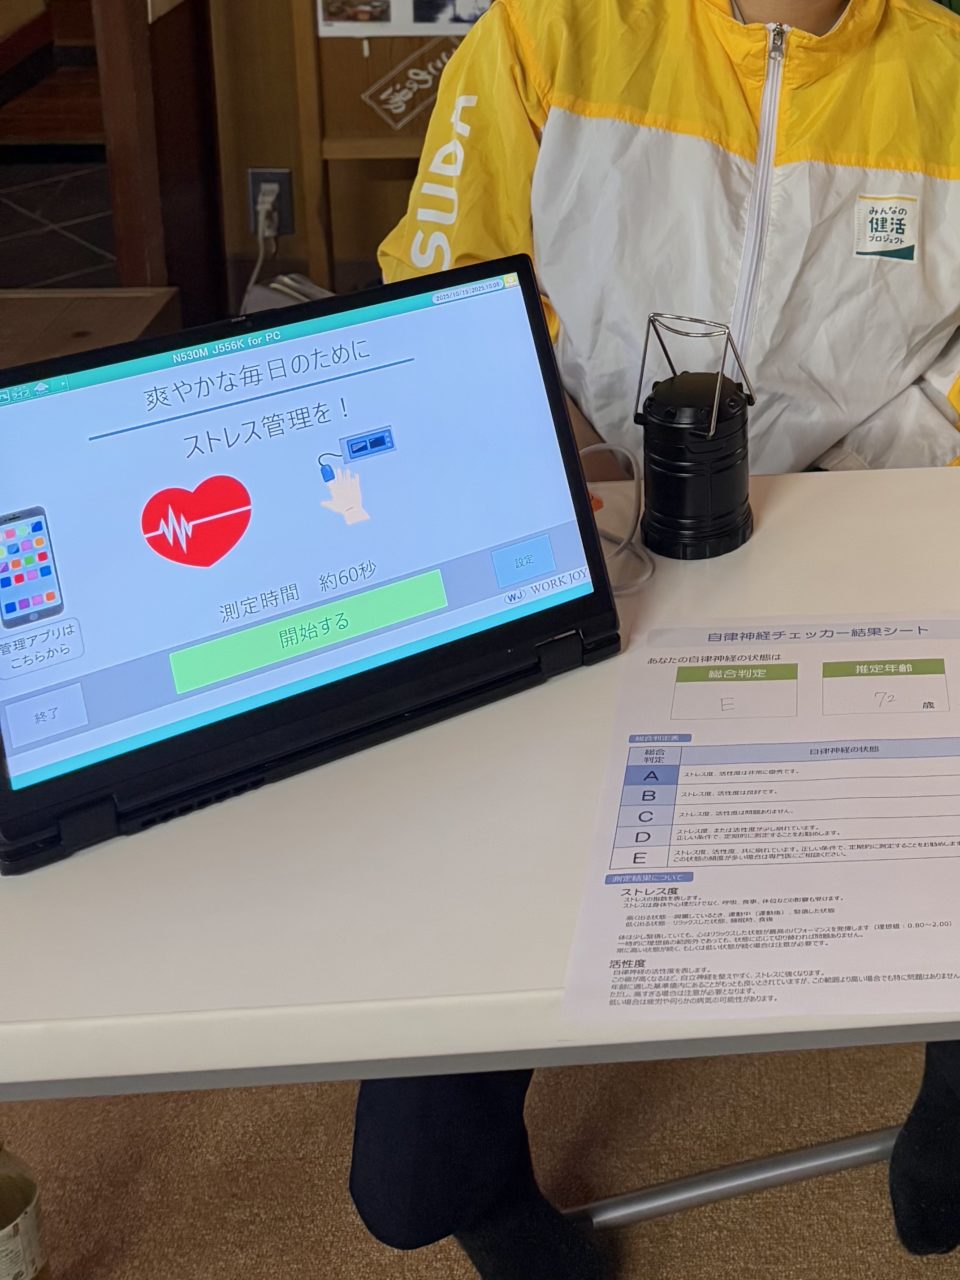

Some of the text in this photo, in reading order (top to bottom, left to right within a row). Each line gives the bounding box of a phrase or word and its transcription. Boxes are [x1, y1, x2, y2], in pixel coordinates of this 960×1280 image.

[868, 206, 908, 216] みんなの
[868, 217, 907, 235] 健活
[868, 234, 905, 245] プロジェクト
[173, 331, 281, 364] N530M J556K for PC
[144, 339, 370, 412] 爽やかな毎日のために
[184, 397, 349, 459] ストレス管理を！
[515, 552, 534, 570] 設定
[219, 560, 378, 624] 測定時間 約60秒
[530, 575, 566, 596] WORK
[279, 611, 350, 649] 開始する
[708, 625, 929, 643] 自律神経チェッカー結果シート
[10, 642, 71, 669] こちらから
[647, 653, 782, 665] あなたの自律神経の状態は
[708, 662, 913, 680] 総合判定 推定年齢
[720, 696, 736, 712] E
[922, 700, 936, 711] 歳
[34, 706, 59, 725] 終了
[644, 745, 880, 757] 総合 自律神経の状態
[643, 756, 665, 764] 判定
[643, 770, 659, 782] A
[641, 790, 656, 802] B
[638, 811, 653, 823] C
[635, 832, 651, 843] D
[632, 852, 648, 865] E
[620, 887, 679, 897] ストレス度
[609, 959, 647, 970] 活性度
